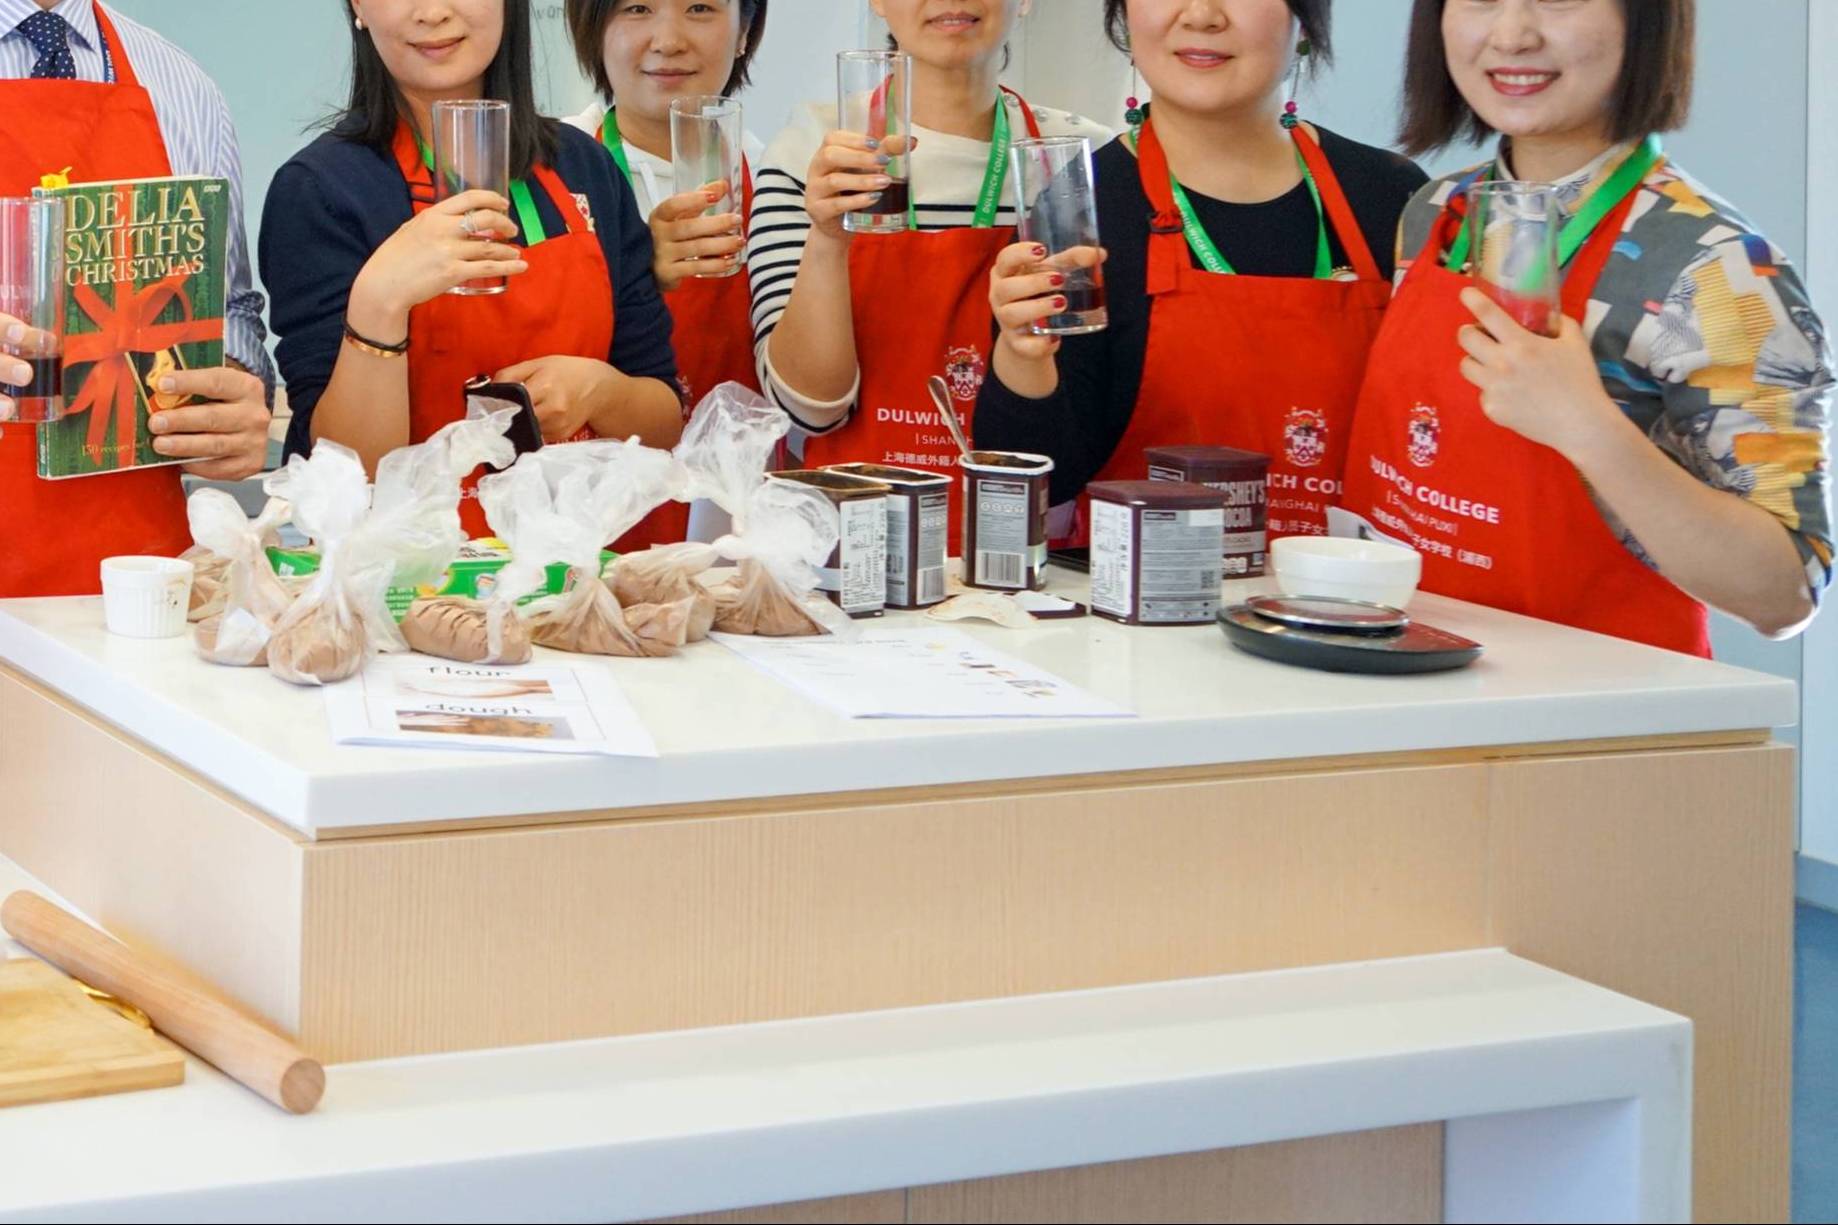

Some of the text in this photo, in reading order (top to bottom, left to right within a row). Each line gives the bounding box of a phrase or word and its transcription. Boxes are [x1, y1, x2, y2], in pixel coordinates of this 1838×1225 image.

[65, 186, 205, 233] DELIA
[65, 223, 205, 264] SMITH'S
[65, 254, 204, 287] CHRISTMAS
[1204, 252, 1227, 274] COLL
[1416, 486, 1500, 525] COLLEGE
[425, 703, 533, 716] dough
